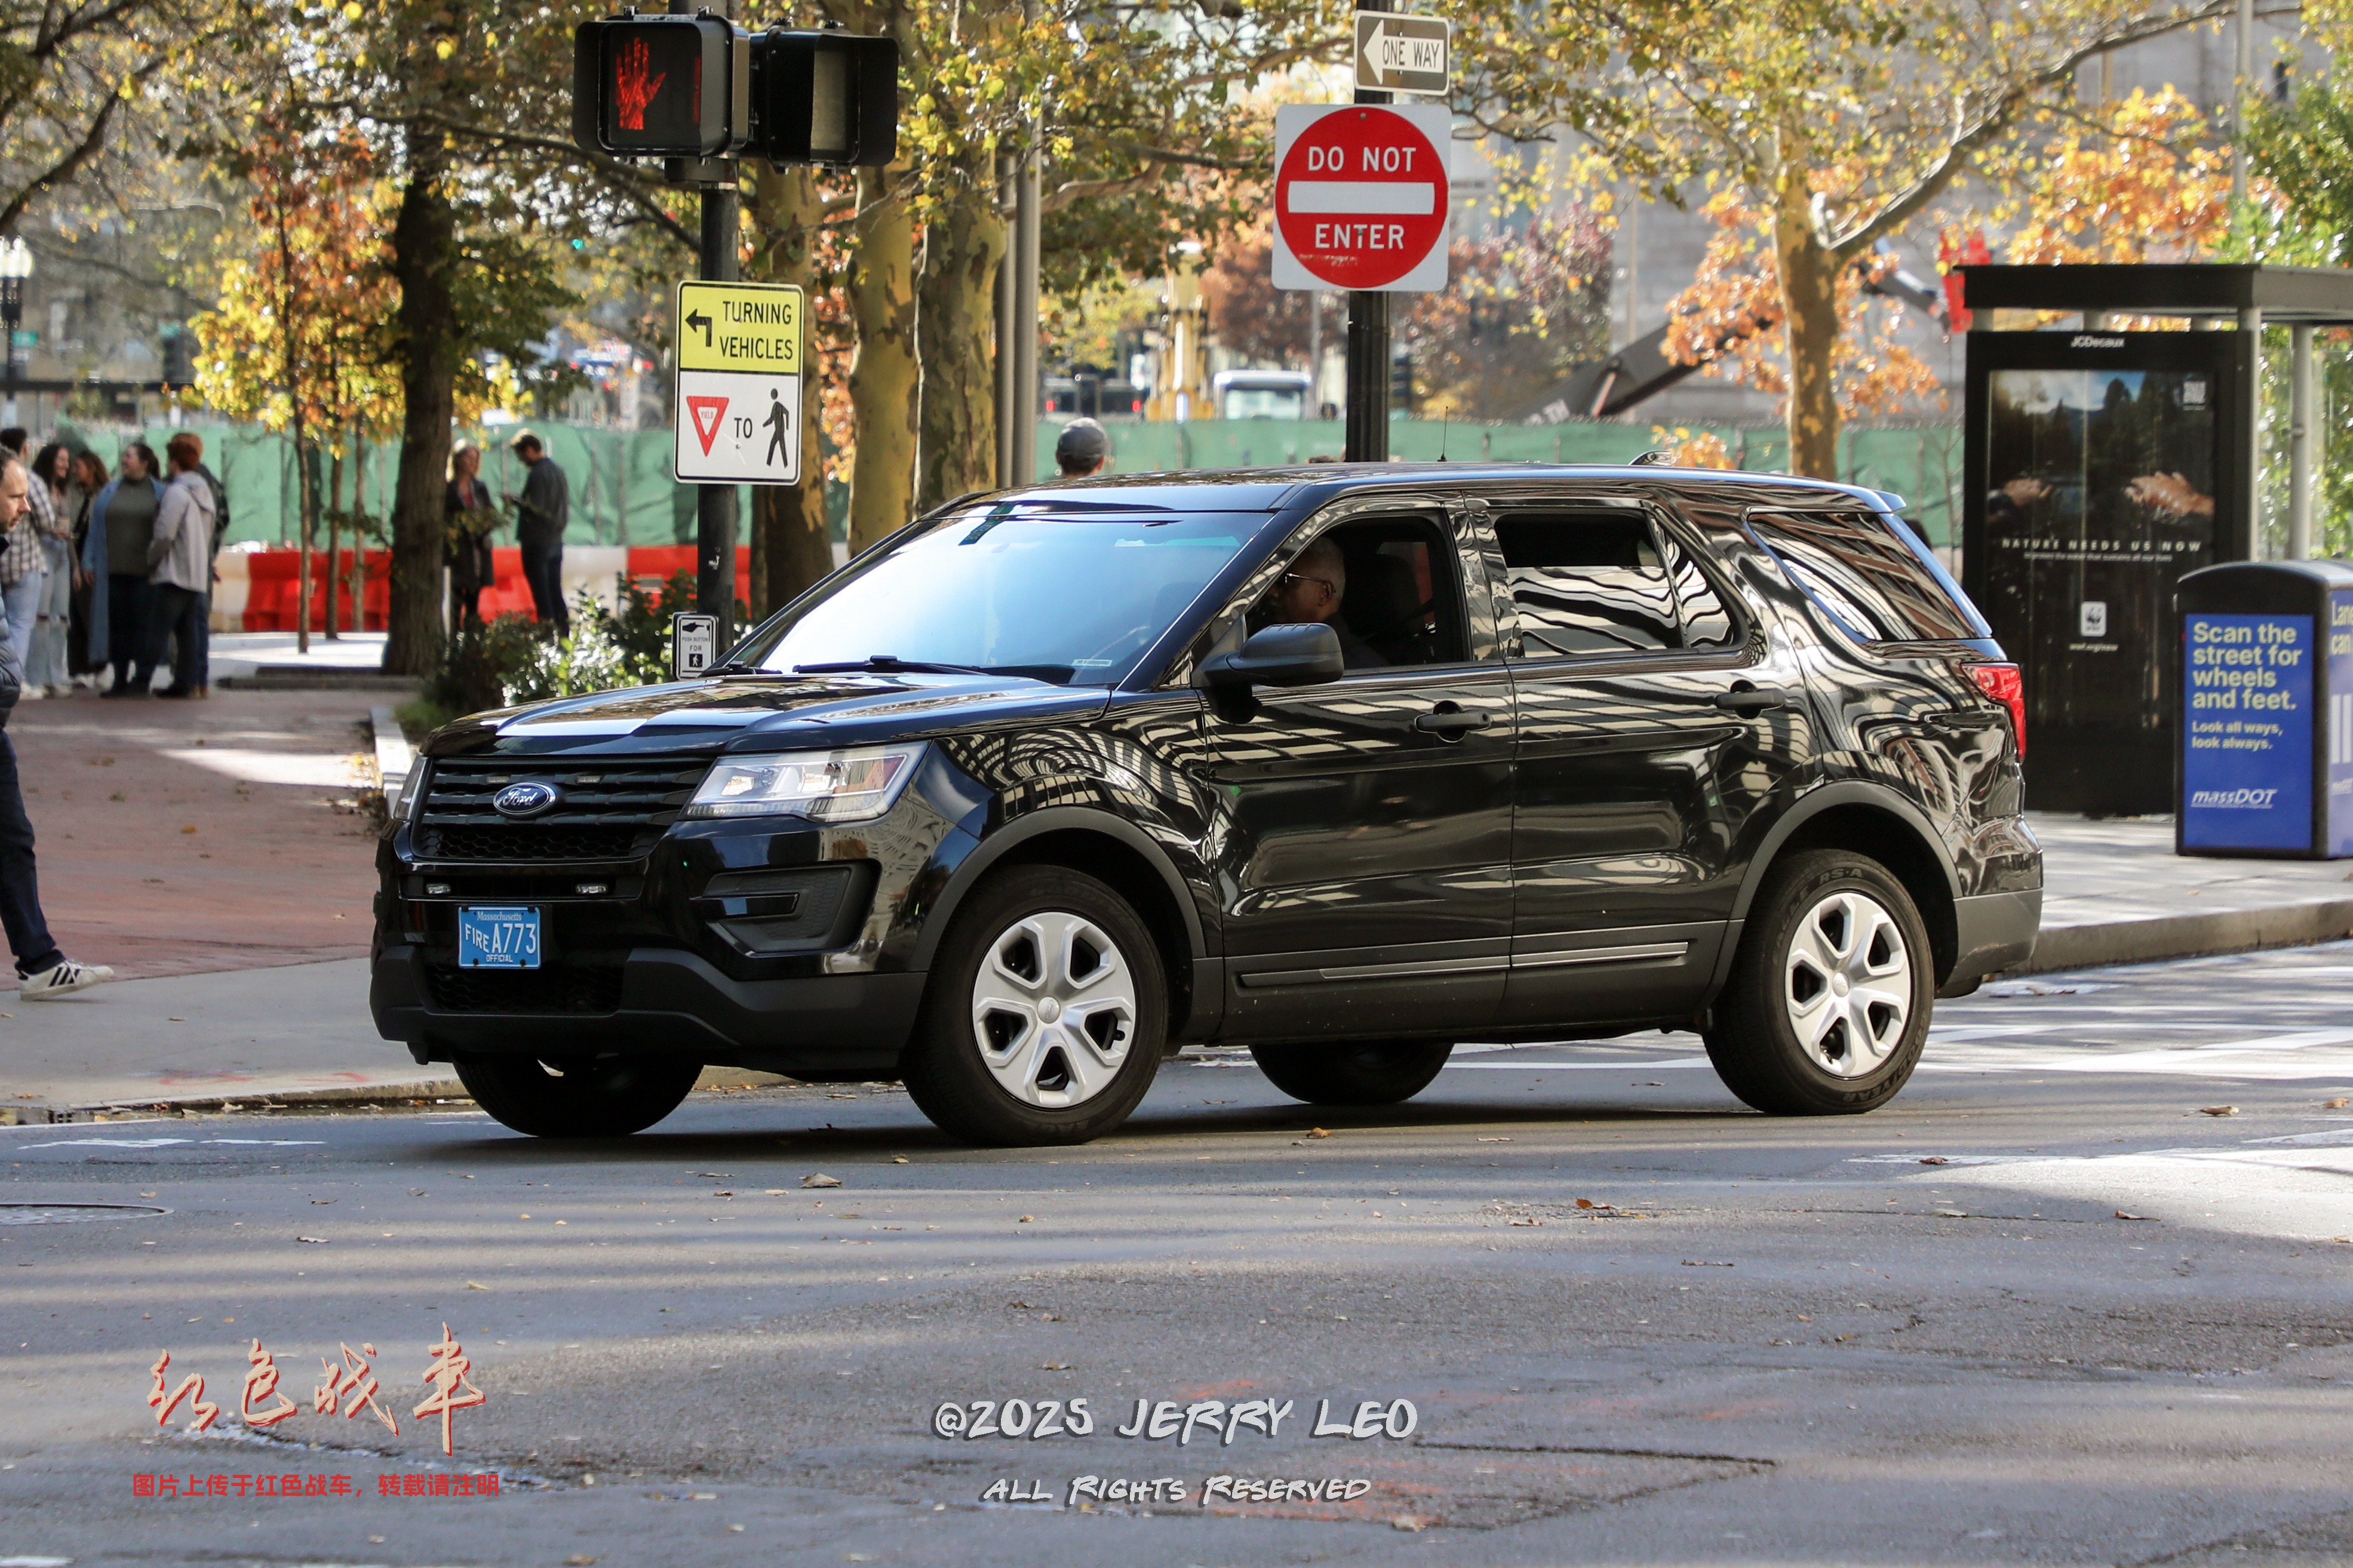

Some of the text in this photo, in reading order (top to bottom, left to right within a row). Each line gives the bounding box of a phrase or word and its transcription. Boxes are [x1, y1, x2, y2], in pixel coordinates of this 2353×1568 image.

[1383, 39, 1441, 68] ONE WAY
[1308, 146, 1416, 172] DO NOT
[1315, 223, 1405, 249] ENTER
[723, 301, 791, 324] TURNING
[719, 336, 793, 360] VEHICLES
[2071, 336, 2125, 348] JCDecaux
[734, 417, 752, 438] TO
[2002, 538, 2201, 552] NATURE NEEDS US NOW
[2192, 621, 2297, 644] Scan the
[2192, 644, 2303, 666] street for
[2192, 666, 2277, 688] wheels
[2192, 688, 2297, 711] and feet.
[2192, 720, 2284, 737] Look all ways,
[2192, 736, 2274, 752] look always.
[503, 787, 538, 806] Ford
[2191, 788, 2278, 805] massDOT
[477, 911, 522, 921] Massachusetts
[465, 923, 536, 954] FIRE A773
[486, 954, 514, 963] OFFICIAL
